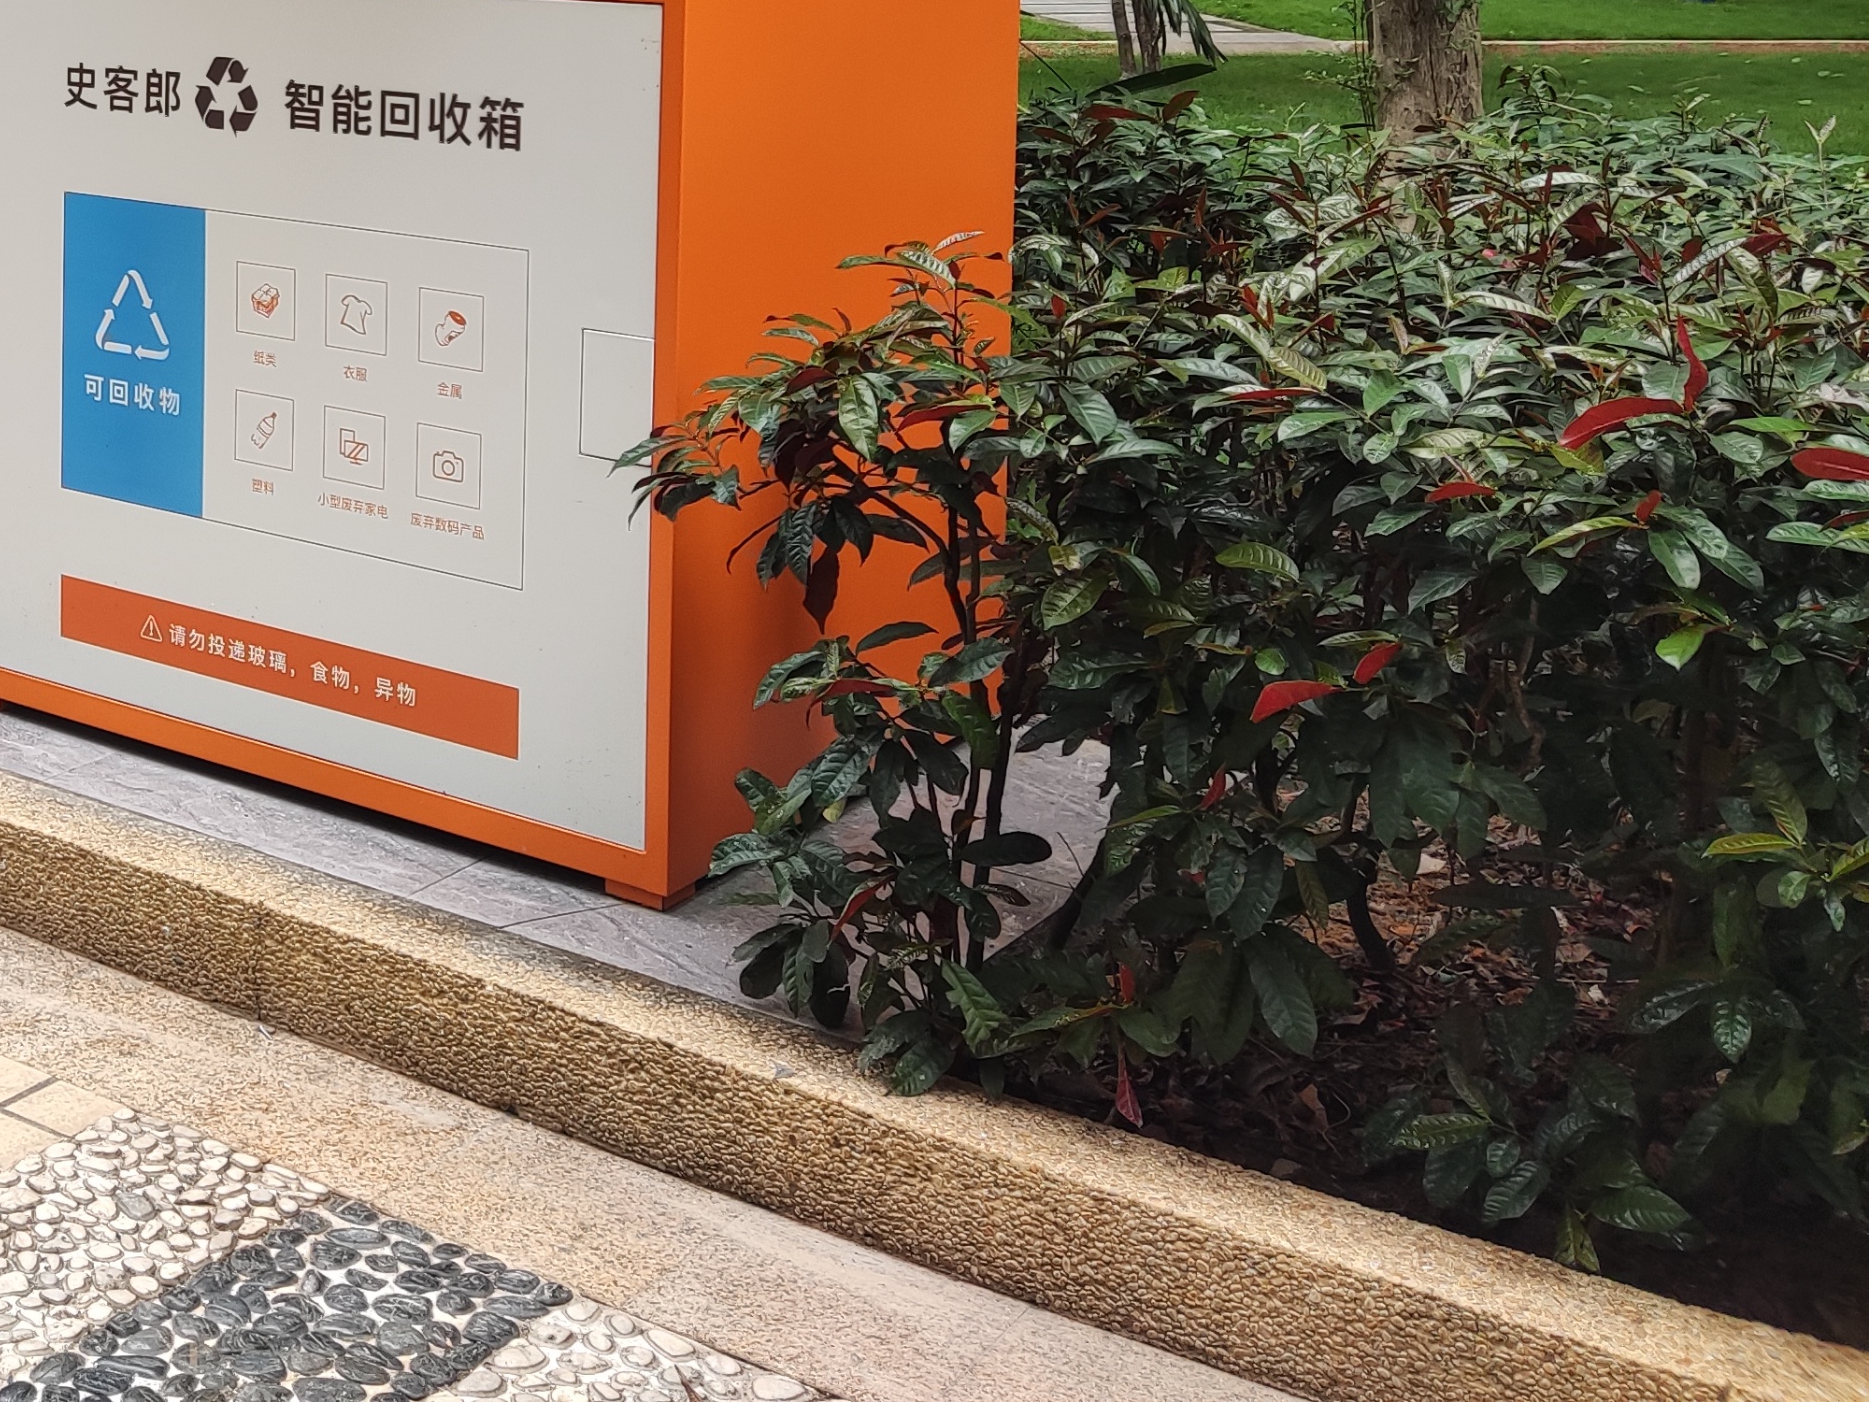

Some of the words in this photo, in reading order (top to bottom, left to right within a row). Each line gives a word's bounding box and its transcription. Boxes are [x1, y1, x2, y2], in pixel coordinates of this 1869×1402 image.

[63, 61, 181, 118] 史客郎
[282, 77, 526, 153] 智能回收箱
[253, 350, 278, 368] 纸类
[342, 364, 369, 383] 衣服
[83, 373, 182, 417] 可回收物
[436, 381, 463, 400] 金属
[251, 478, 275, 496] 塑料
[317, 492, 389, 520] 小型废弃家电
[410, 512, 486, 541] 废弃数码产品
[168, 622, 418, 709] 请勿投递玻璃，食物，异物
